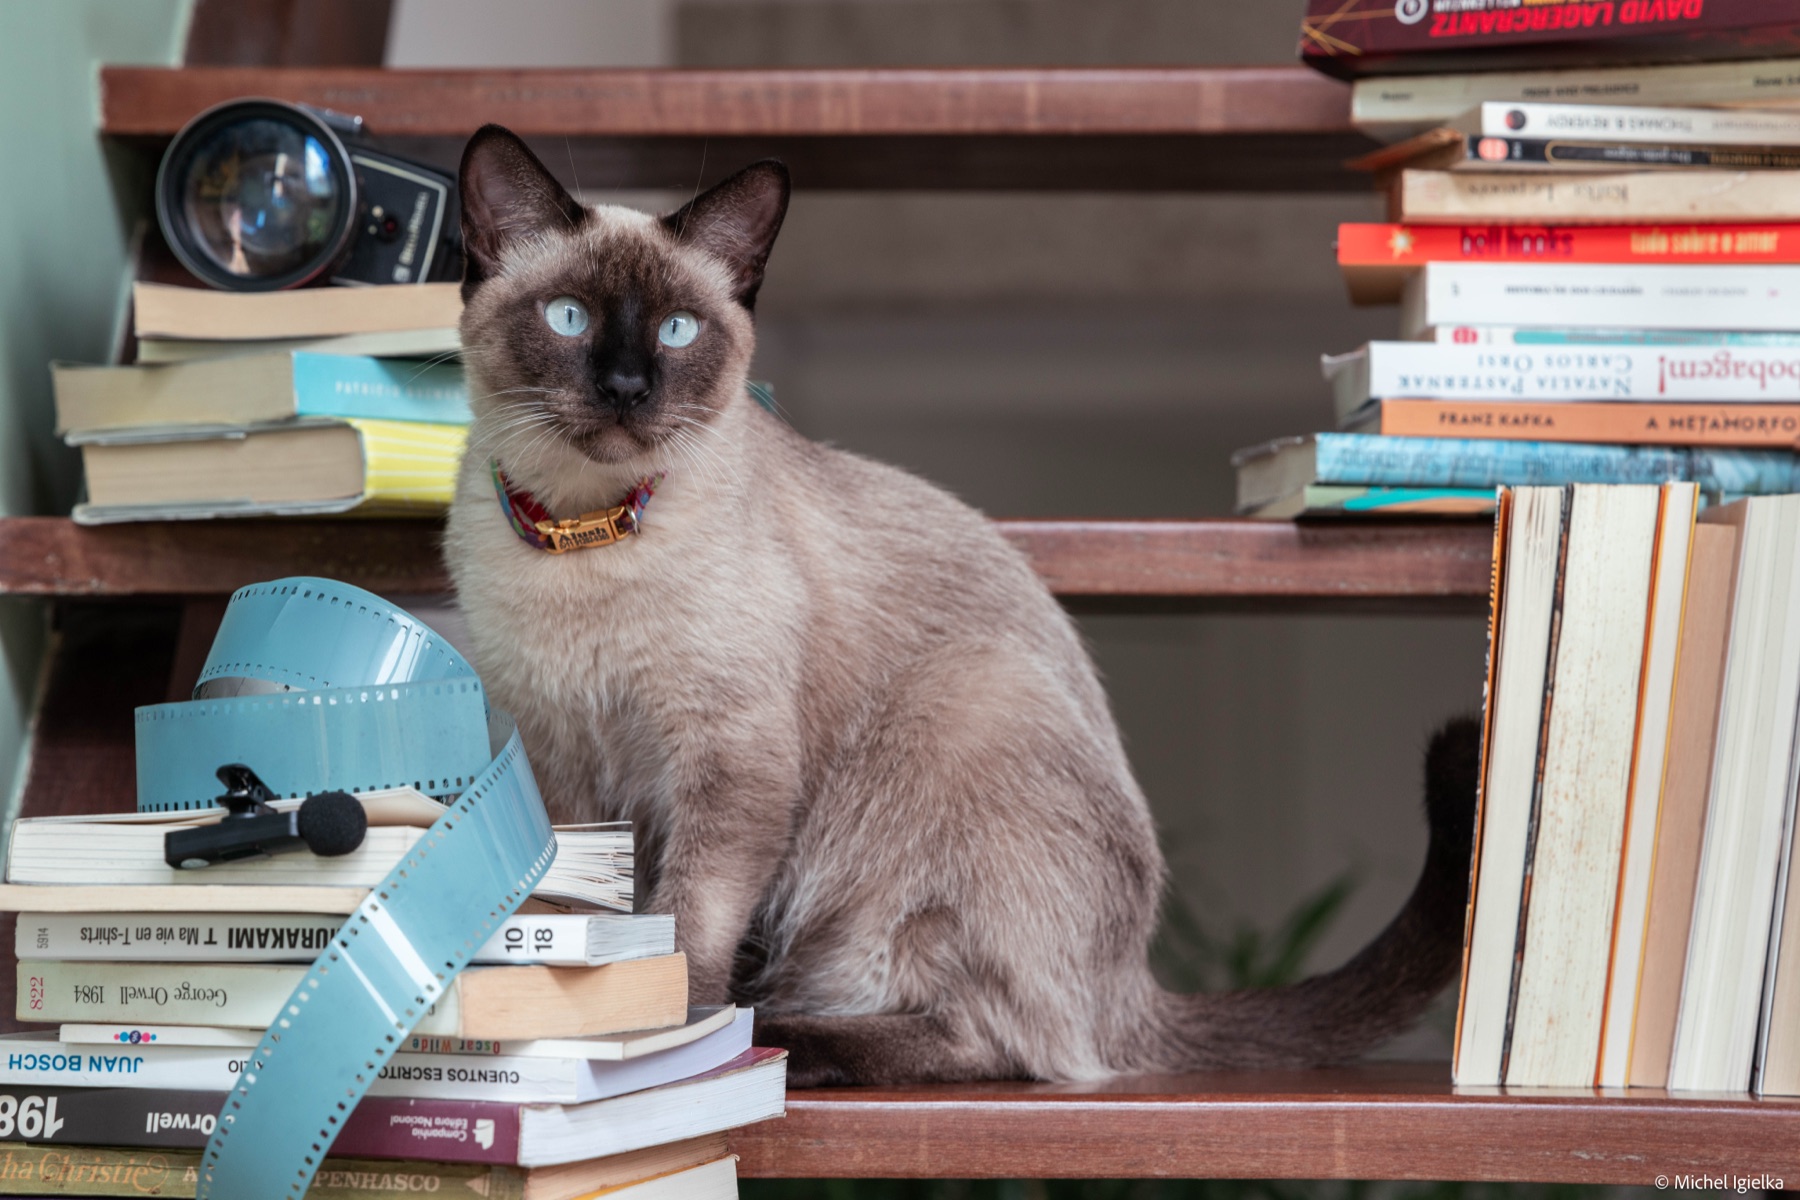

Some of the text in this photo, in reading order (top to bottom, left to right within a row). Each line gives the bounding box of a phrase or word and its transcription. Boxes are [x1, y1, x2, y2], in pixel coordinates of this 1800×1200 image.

[1429, 1, 1614, 37] LAGERCRANTZ
[1619, 0, 1703, 25] DAVID
[1545, 112, 1608, 132] REVERDY
[1629, 113, 1692, 135] THOMAS
[1477, 354, 1632, 373] CARLOS ORSI
[1397, 374, 1632, 396] NATALIA PASTERNAK
[1439, 412, 1493, 427] FRANZ
[1498, 413, 1555, 427] KAFKA
[1645, 416, 1659, 431] A
[36, 927, 49, 949] 5914
[80, 926, 132, 946] T-shirts
[135, 926, 152, 942] en
[156, 927, 175, 945] vie
[178, 927, 199, 945] Ma
[203, 927, 217, 946] T
[505, 928, 523, 953] 10
[534, 928, 553, 953] 18
[29, 976, 44, 1011] 822
[73, 981, 228, 1008] George Orwell 1984
[412, 1038, 501, 1055] Oscar Wilde
[8, 1054, 144, 1073] JUAN BOSCH
[377, 1065, 520, 1084] CUENTOS ESCRITO
[145, 1112, 217, 1136] Orwell
[389, 1115, 468, 1130] Editora Nacional
[411, 1127, 468, 1142] Companhia
[41, 1151, 169, 1192] Christie
[182, 1165, 198, 1183] A
[311, 1170, 441, 1193] PENHASCO
